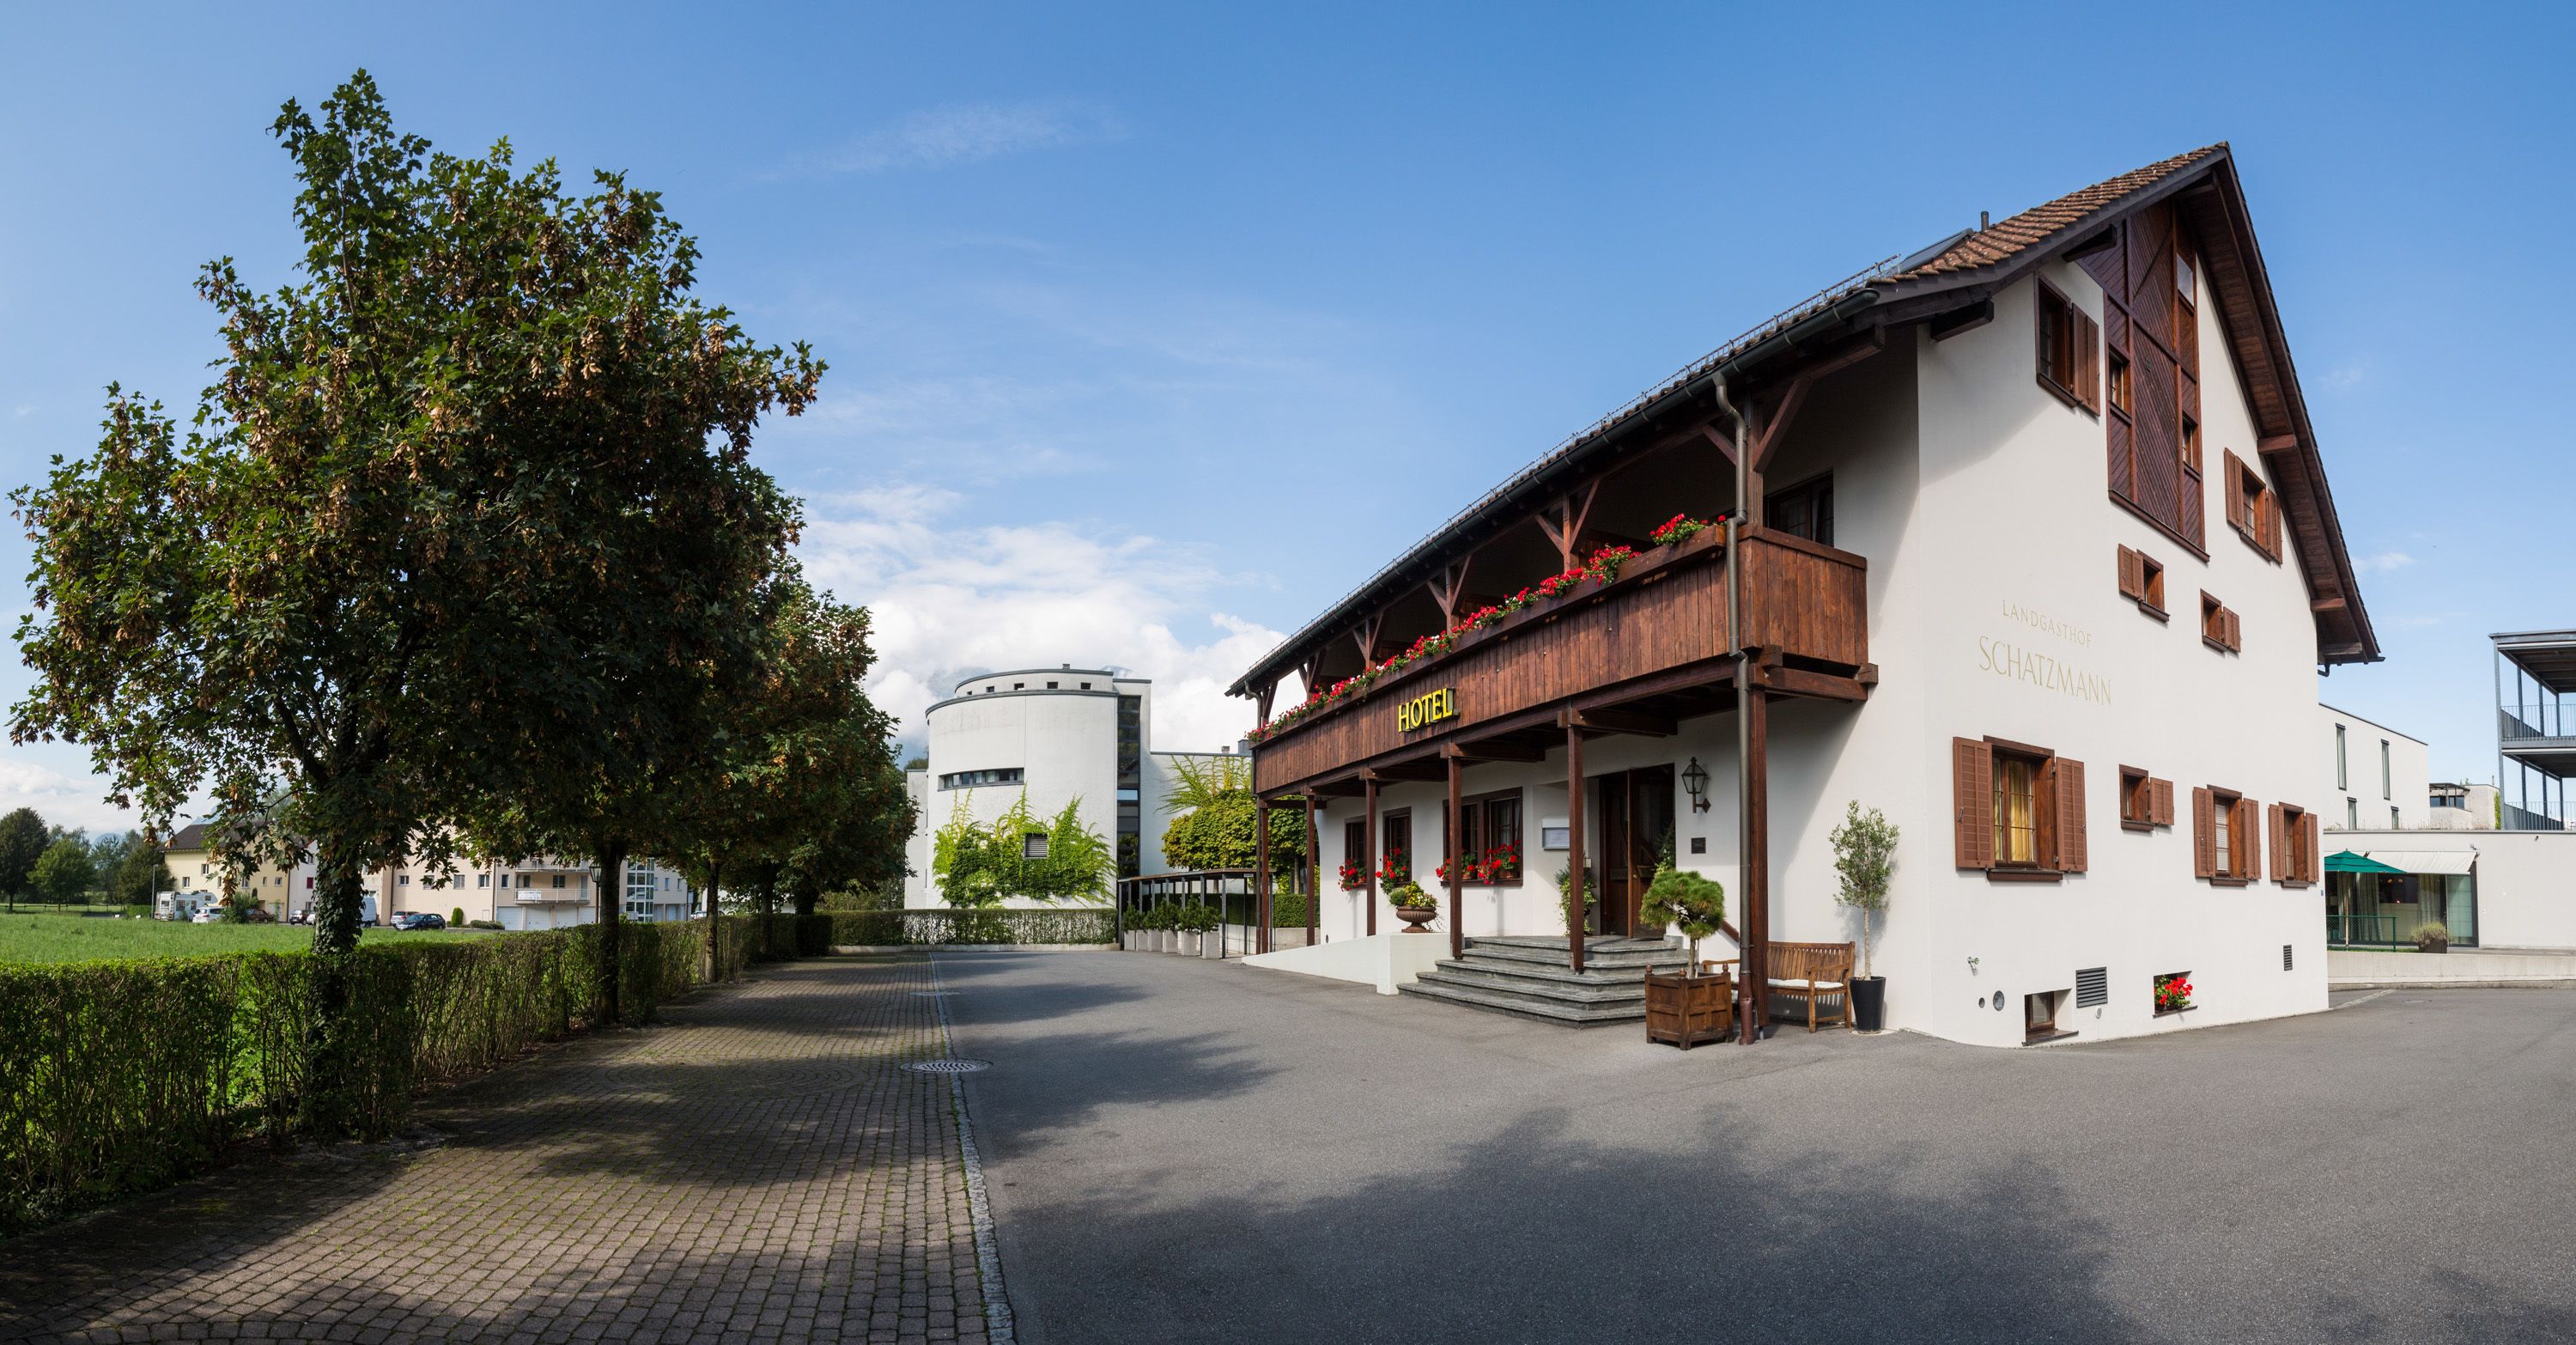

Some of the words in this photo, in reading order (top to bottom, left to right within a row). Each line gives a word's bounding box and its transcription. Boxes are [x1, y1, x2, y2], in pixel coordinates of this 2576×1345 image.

[2002, 599, 2092, 648] LANDGASTHOF
[1978, 636, 2111, 706] SCHATZMANN
[1398, 687, 1453, 733] HOTEL
